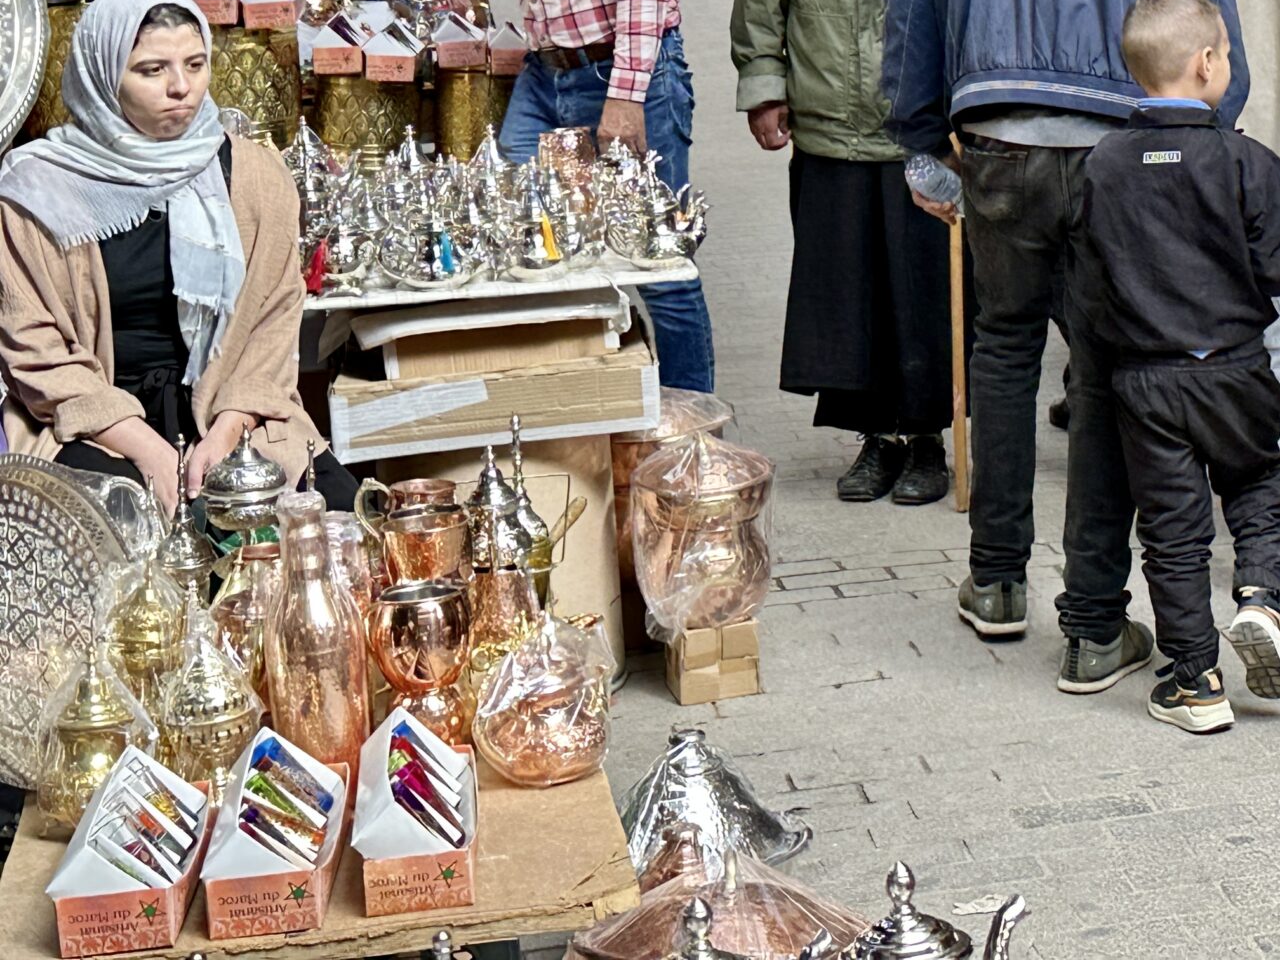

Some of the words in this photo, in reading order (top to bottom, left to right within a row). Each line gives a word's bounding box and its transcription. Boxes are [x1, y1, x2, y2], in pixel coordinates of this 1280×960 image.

[413, 873, 430, 883] du
[218, 893, 258, 906] Maroc
[262, 891, 280, 902] du
[68, 911, 110, 924] Maroc
[113, 909, 131, 920] du
[229, 904, 288, 918] Artisanat
[80, 921, 139, 936] Artisanat
